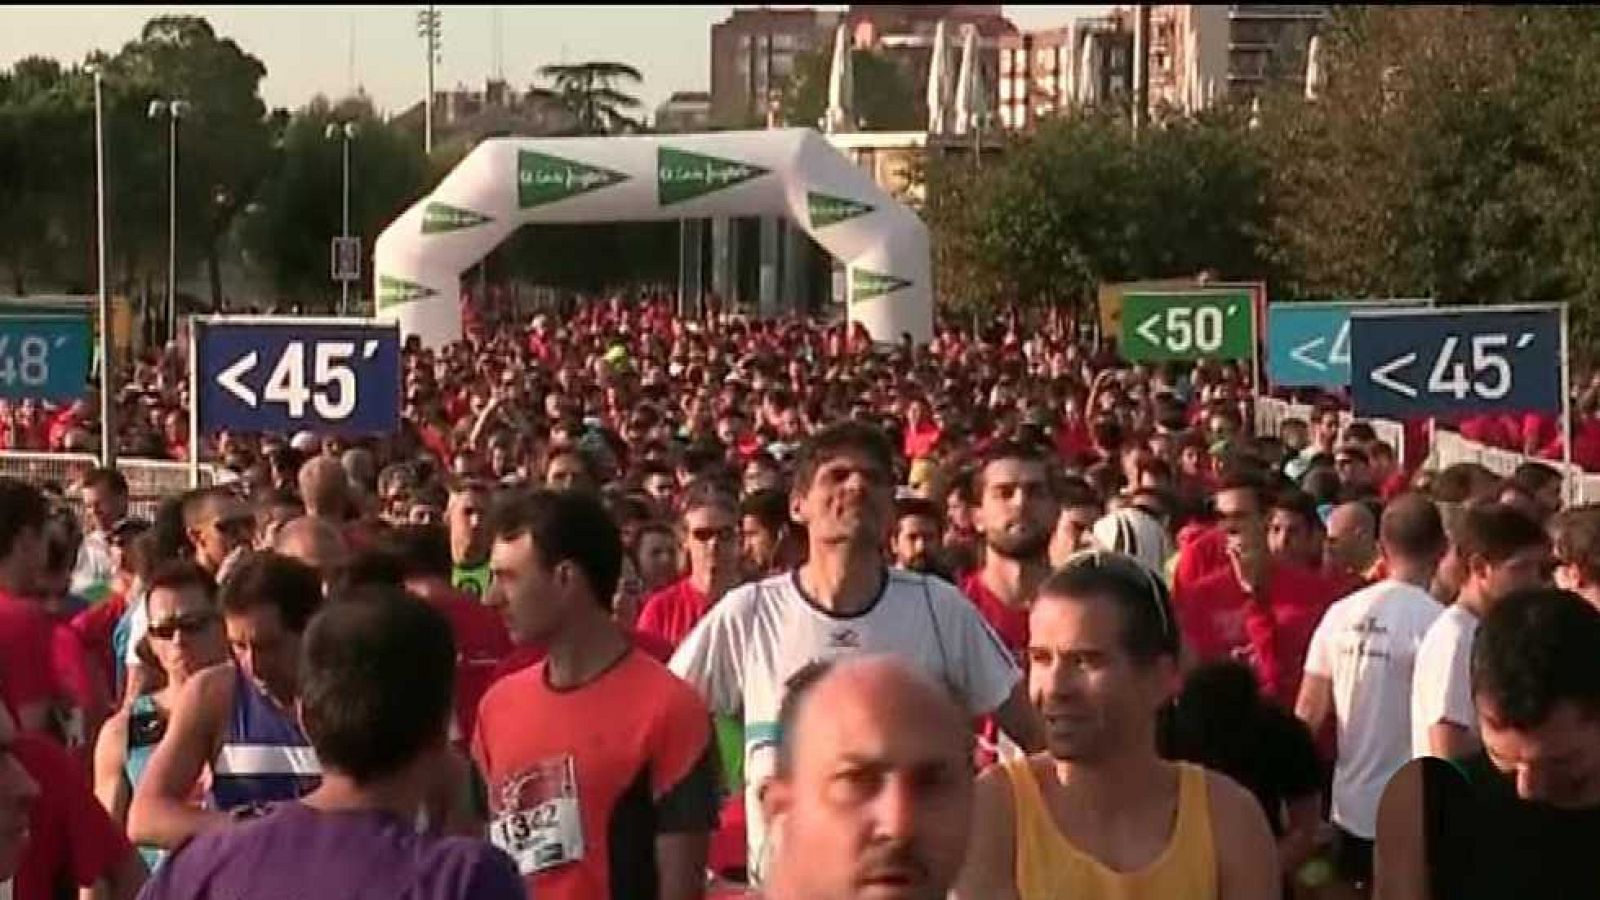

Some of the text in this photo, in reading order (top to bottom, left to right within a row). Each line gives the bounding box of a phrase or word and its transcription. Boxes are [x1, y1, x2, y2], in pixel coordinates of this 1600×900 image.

[1135, 305, 1237, 352] <50'
[215, 340, 379, 419] <45'
[1369, 332, 1534, 399] <45'
